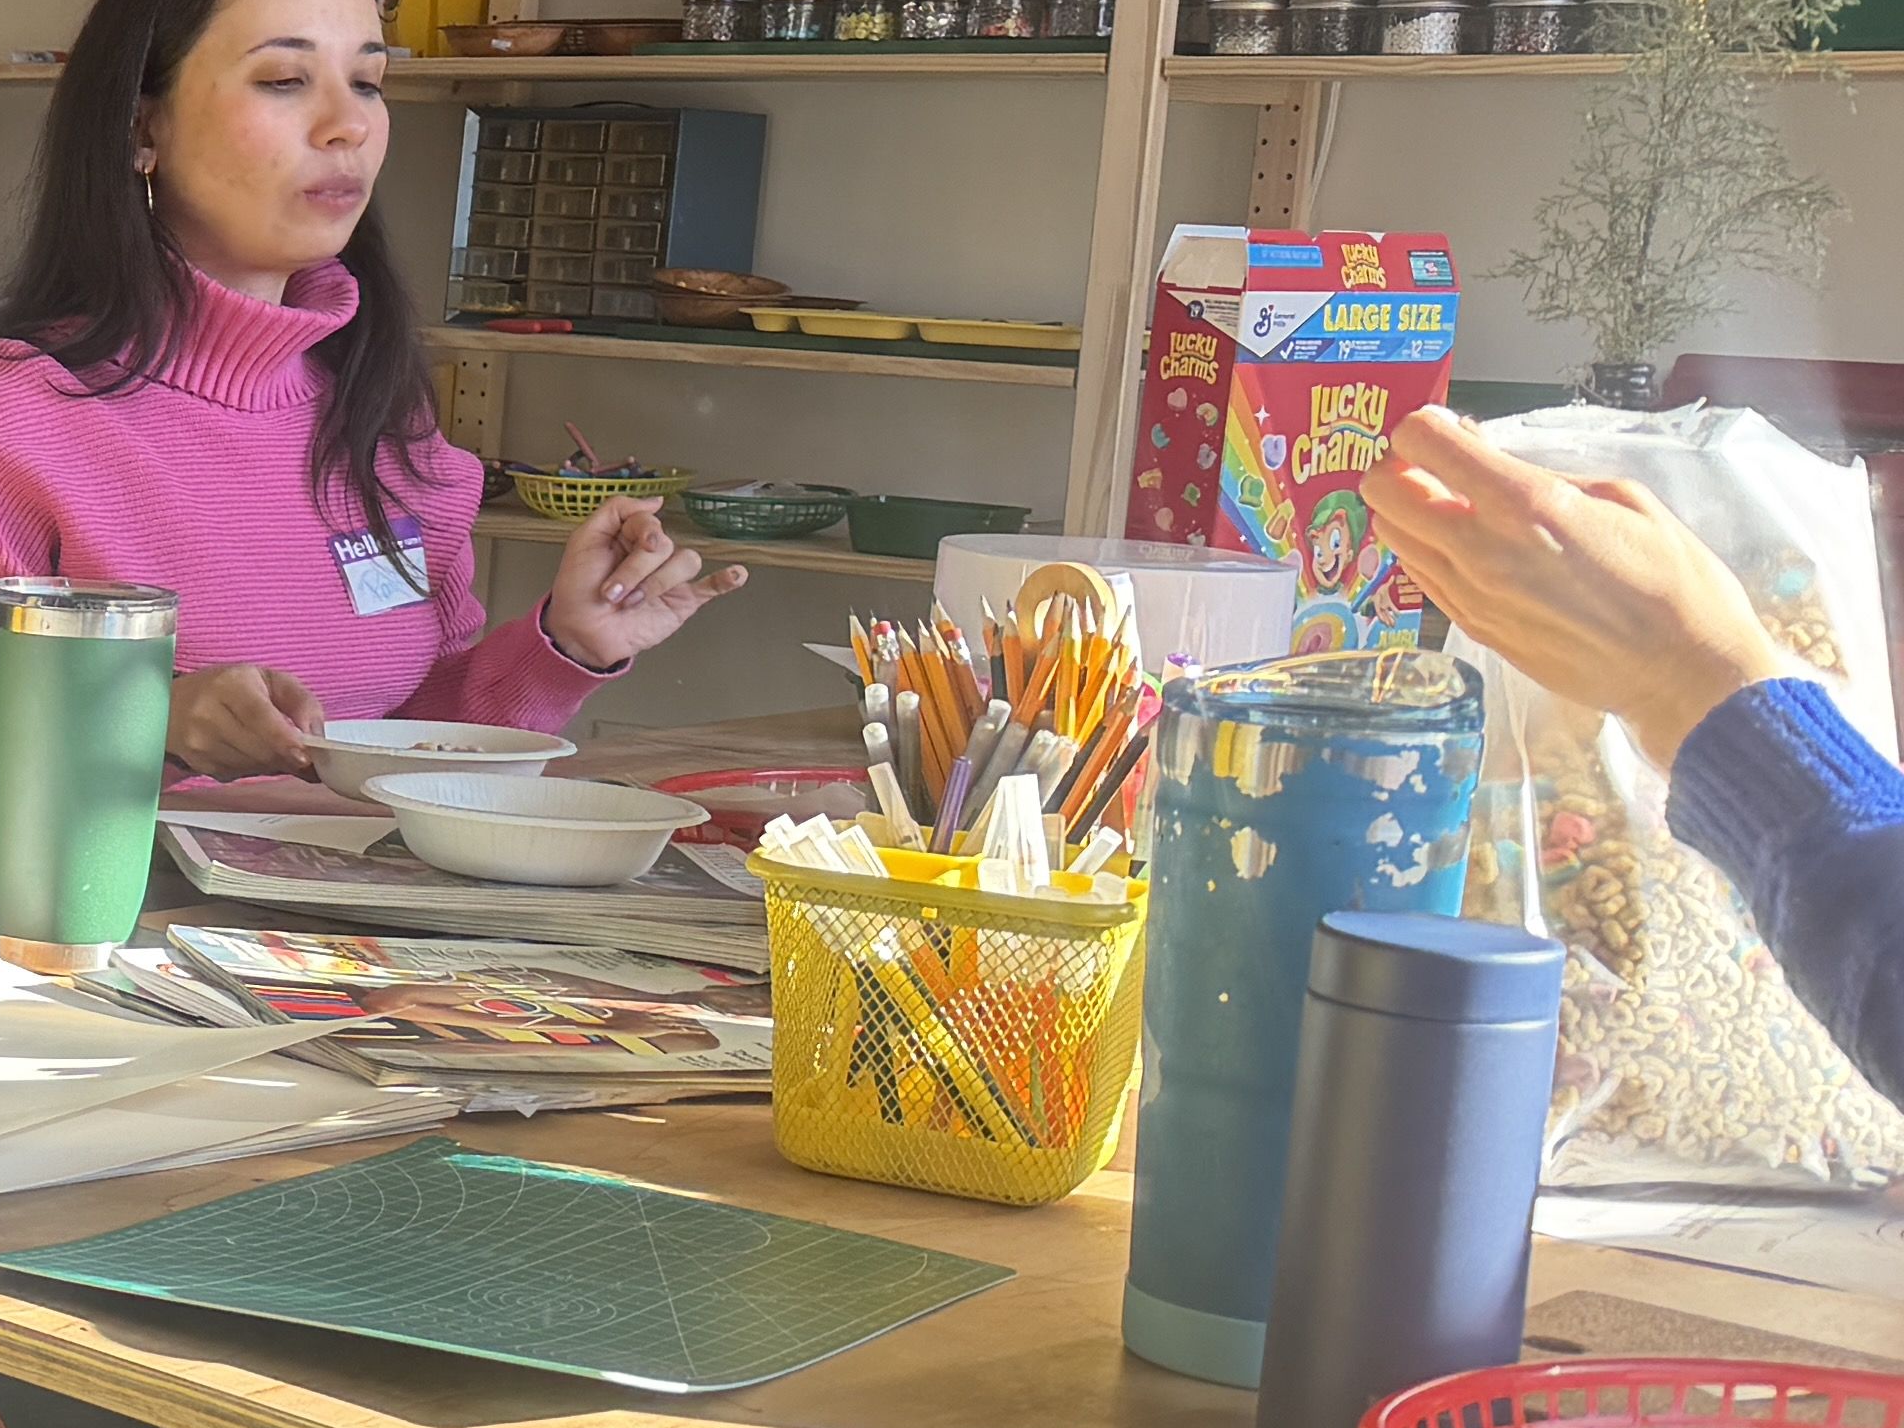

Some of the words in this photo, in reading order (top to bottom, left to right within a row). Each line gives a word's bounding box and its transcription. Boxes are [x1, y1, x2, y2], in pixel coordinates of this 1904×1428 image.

[1341, 243, 1379, 268] Lucky
[1341, 265, 1387, 290] Charms
[1323, 303, 1392, 332] LARGE
[1398, 303, 1443, 332] SIZE
[1170, 331, 1218, 361] Lucky
[1160, 355, 1220, 385] Charms
[1310, 382, 1389, 436] Lucky
[334, 533, 382, 561] Hell
